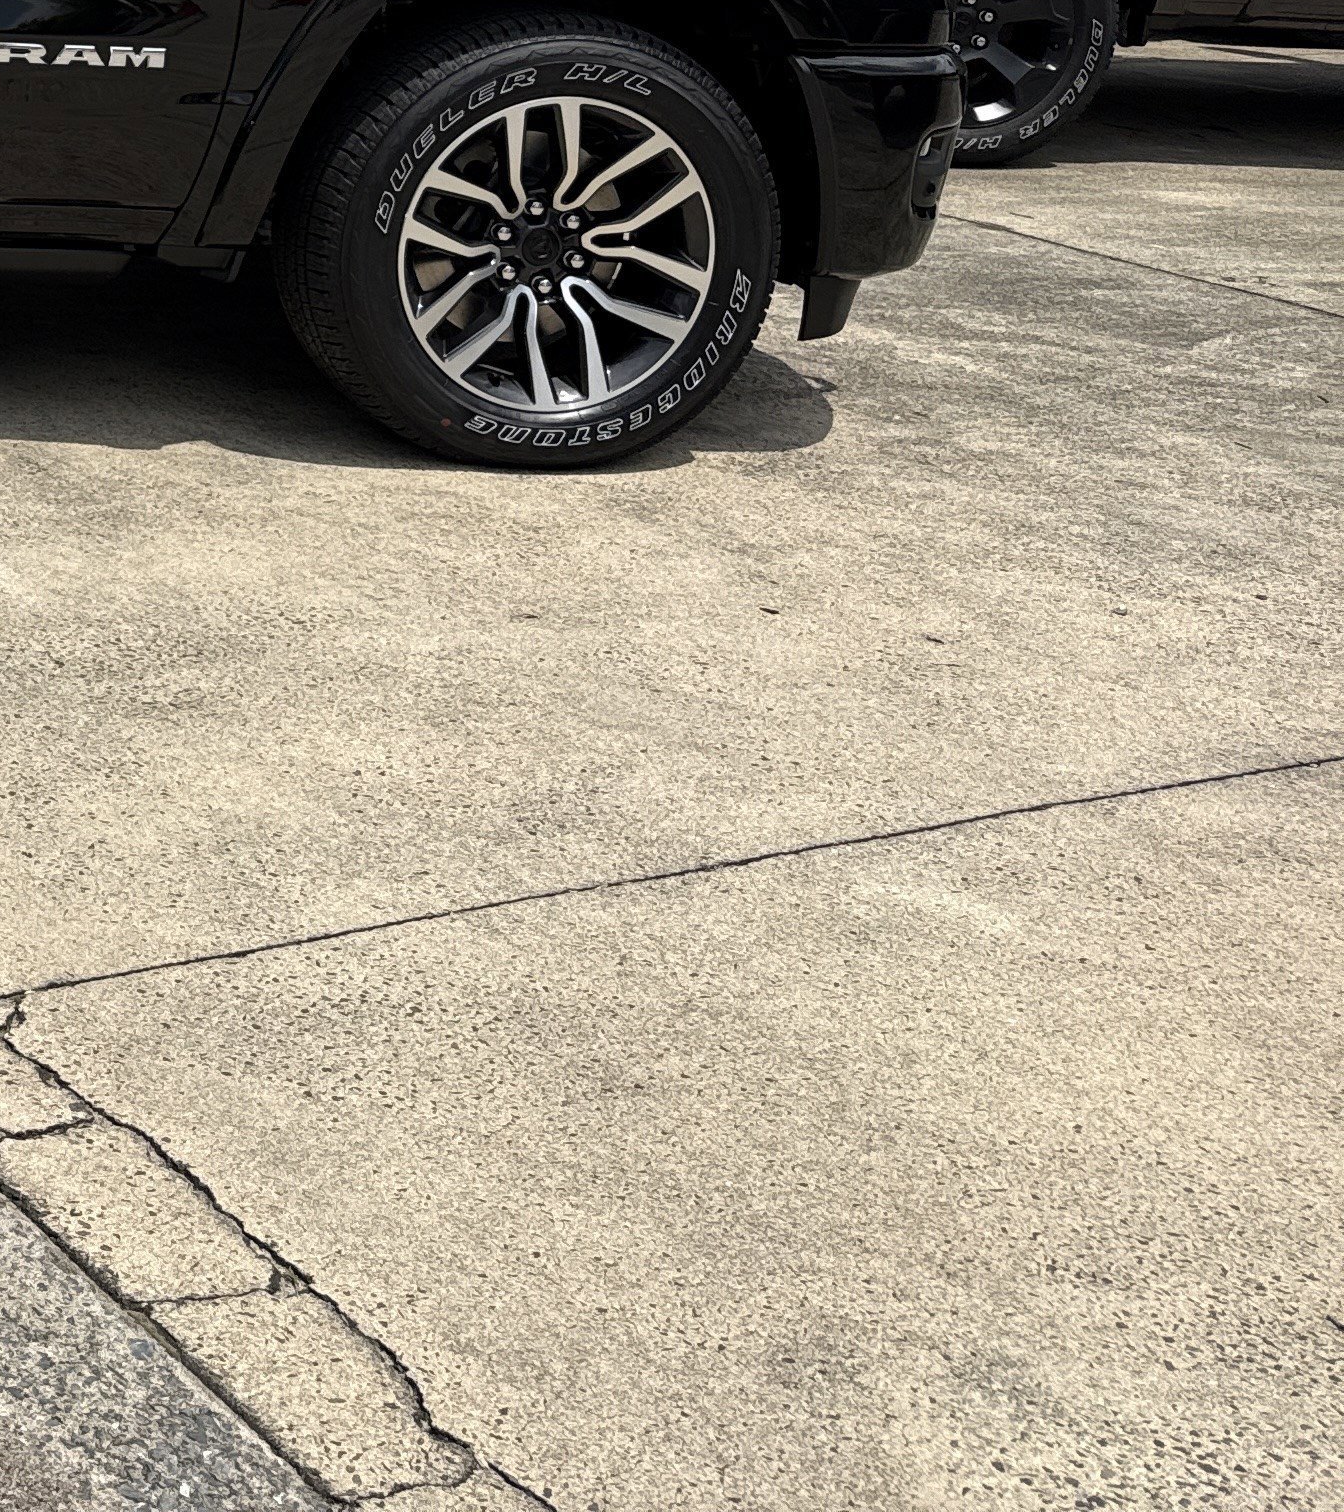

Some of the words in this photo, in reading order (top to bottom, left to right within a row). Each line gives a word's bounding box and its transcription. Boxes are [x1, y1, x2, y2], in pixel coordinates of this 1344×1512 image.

[376, 68, 538, 234] DUELER
[564, 63, 652, 95] H/L
[1019, 18, 1104, 140] DUELER
[464, 268, 752, 447] BRIDGESTONE
